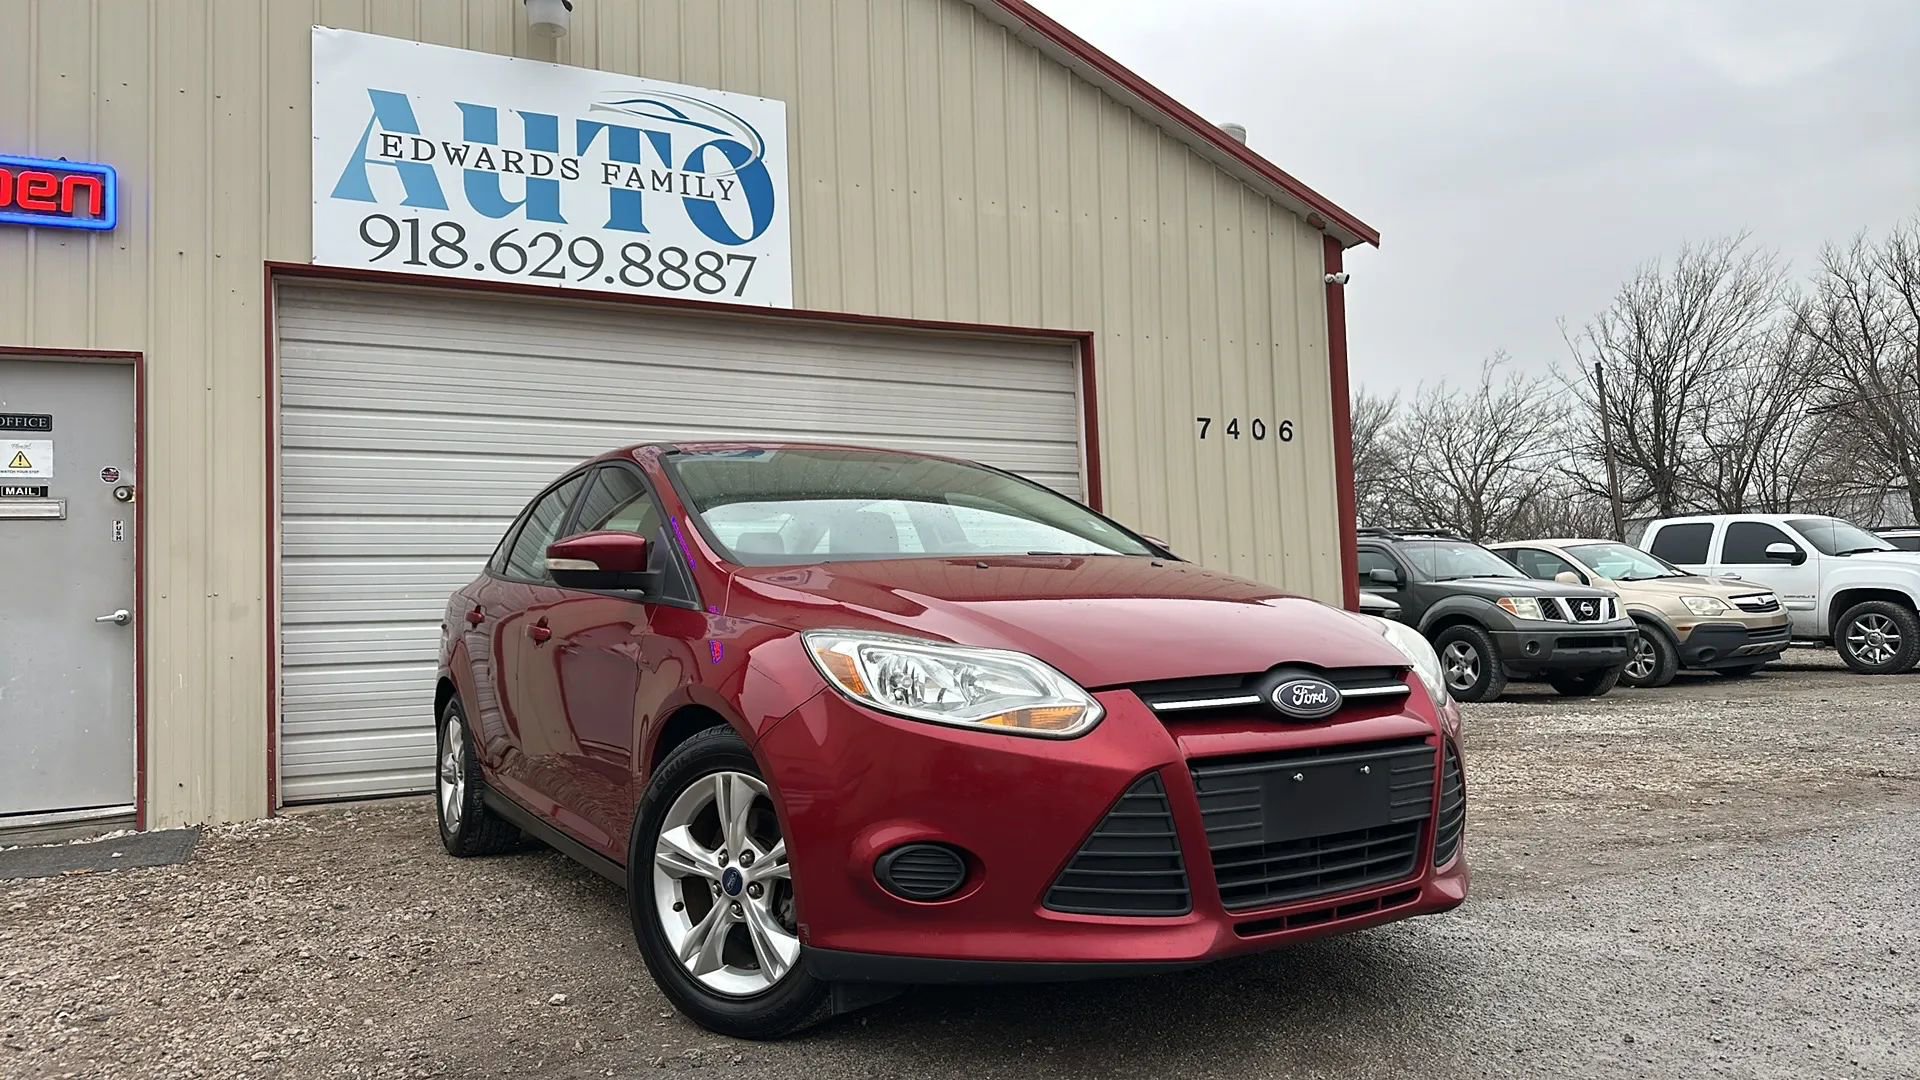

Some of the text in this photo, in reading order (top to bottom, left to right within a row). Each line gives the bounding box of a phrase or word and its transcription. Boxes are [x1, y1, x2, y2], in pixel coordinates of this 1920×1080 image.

[330, 88, 775, 246] AUTO
[379, 132, 736, 202] EDWARDS FAMILY
[0, 168, 101, 215] en
[359, 213, 757, 297] 918.629.8887
[1196, 417, 1293, 442] 7406
[5, 487, 36, 495] MAIL
[1292, 684, 1328, 706] Ford
